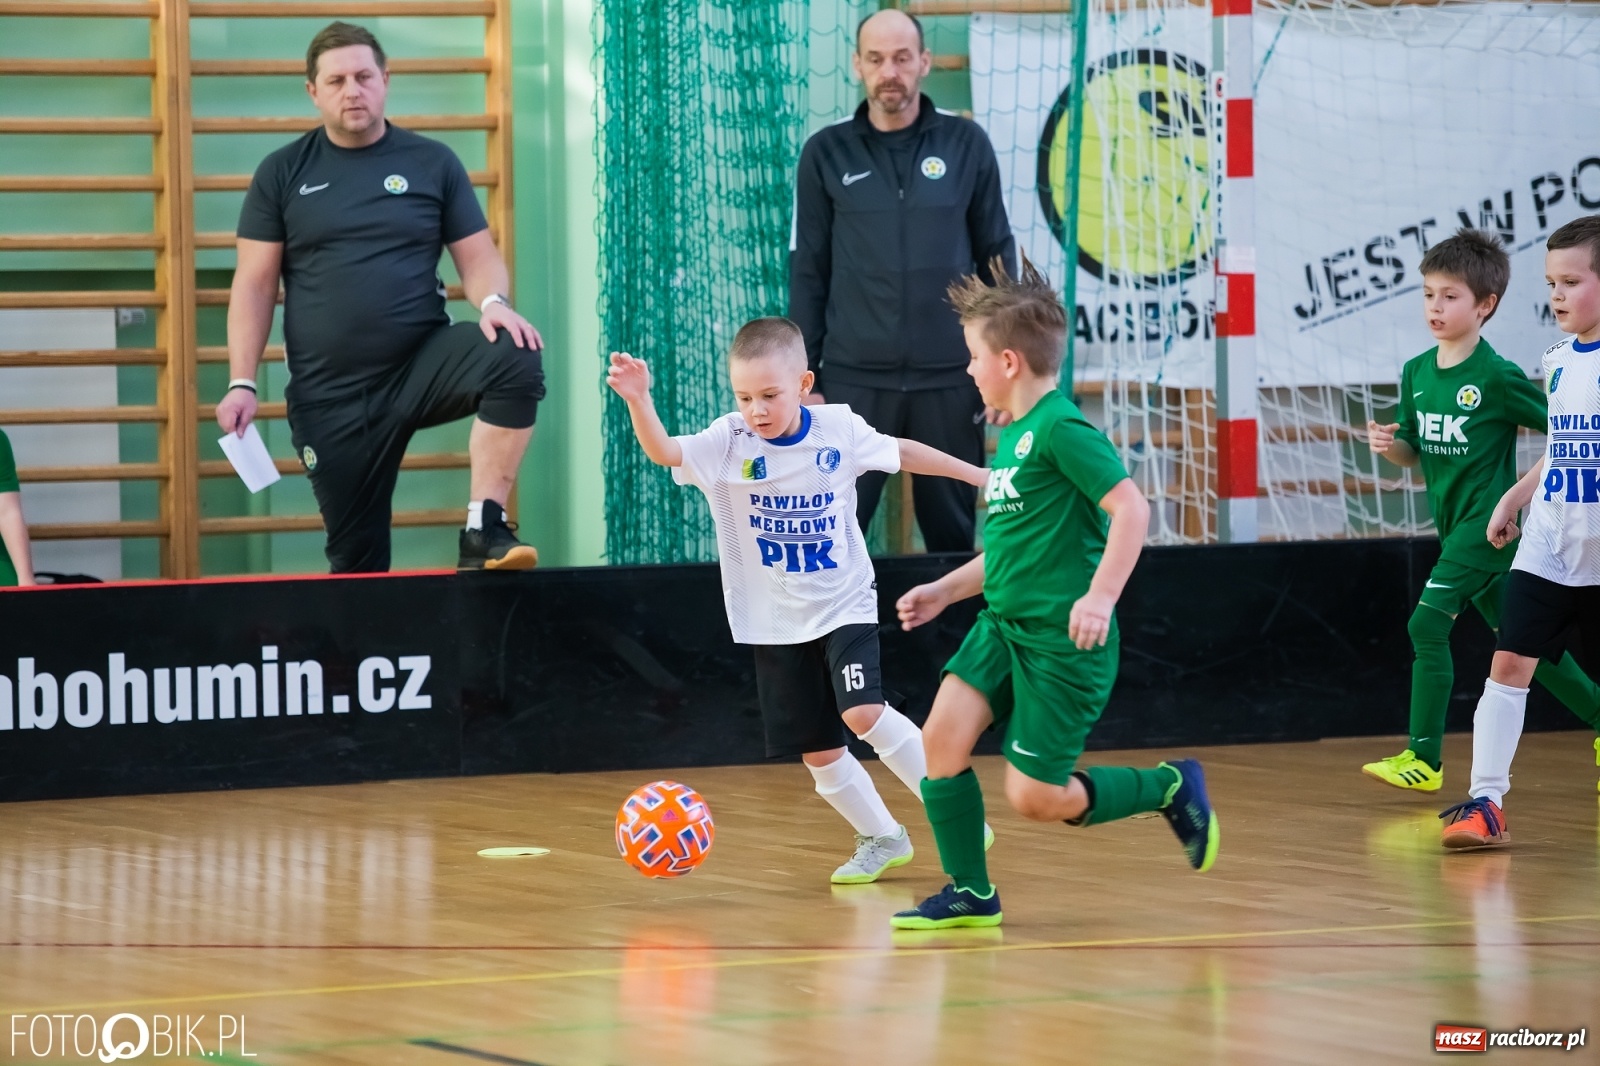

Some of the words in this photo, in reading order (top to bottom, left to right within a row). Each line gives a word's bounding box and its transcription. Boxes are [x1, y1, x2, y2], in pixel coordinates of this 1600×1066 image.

[1294, 218, 1437, 319] JEST
[749, 492, 834, 509] PAWILON
[749, 515, 836, 534] MEBLOWY
[756, 537, 838, 572] PIK
[841, 663, 865, 692] 15
